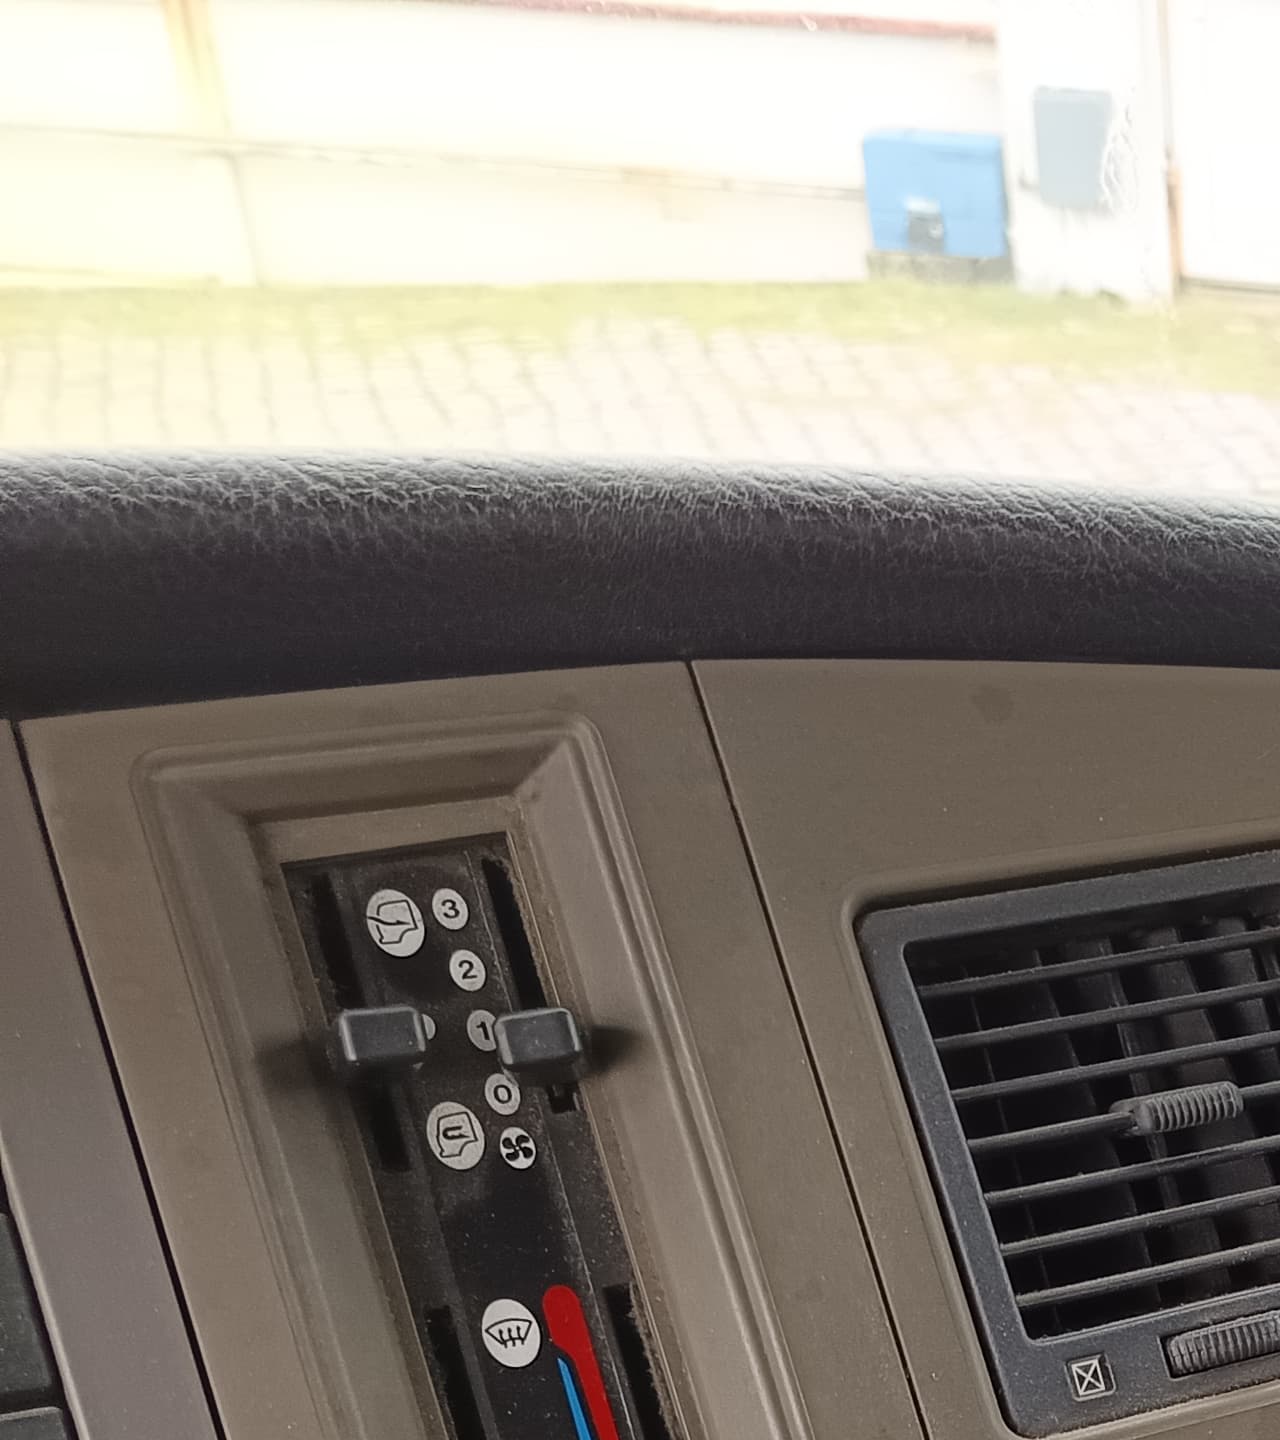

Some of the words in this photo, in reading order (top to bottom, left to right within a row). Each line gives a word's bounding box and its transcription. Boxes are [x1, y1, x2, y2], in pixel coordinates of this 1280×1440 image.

[441, 899, 460, 920] 3
[458, 960, 478, 981] 2
[476, 1021, 490, 1041] 1
[493, 1084, 512, 1104] 0
